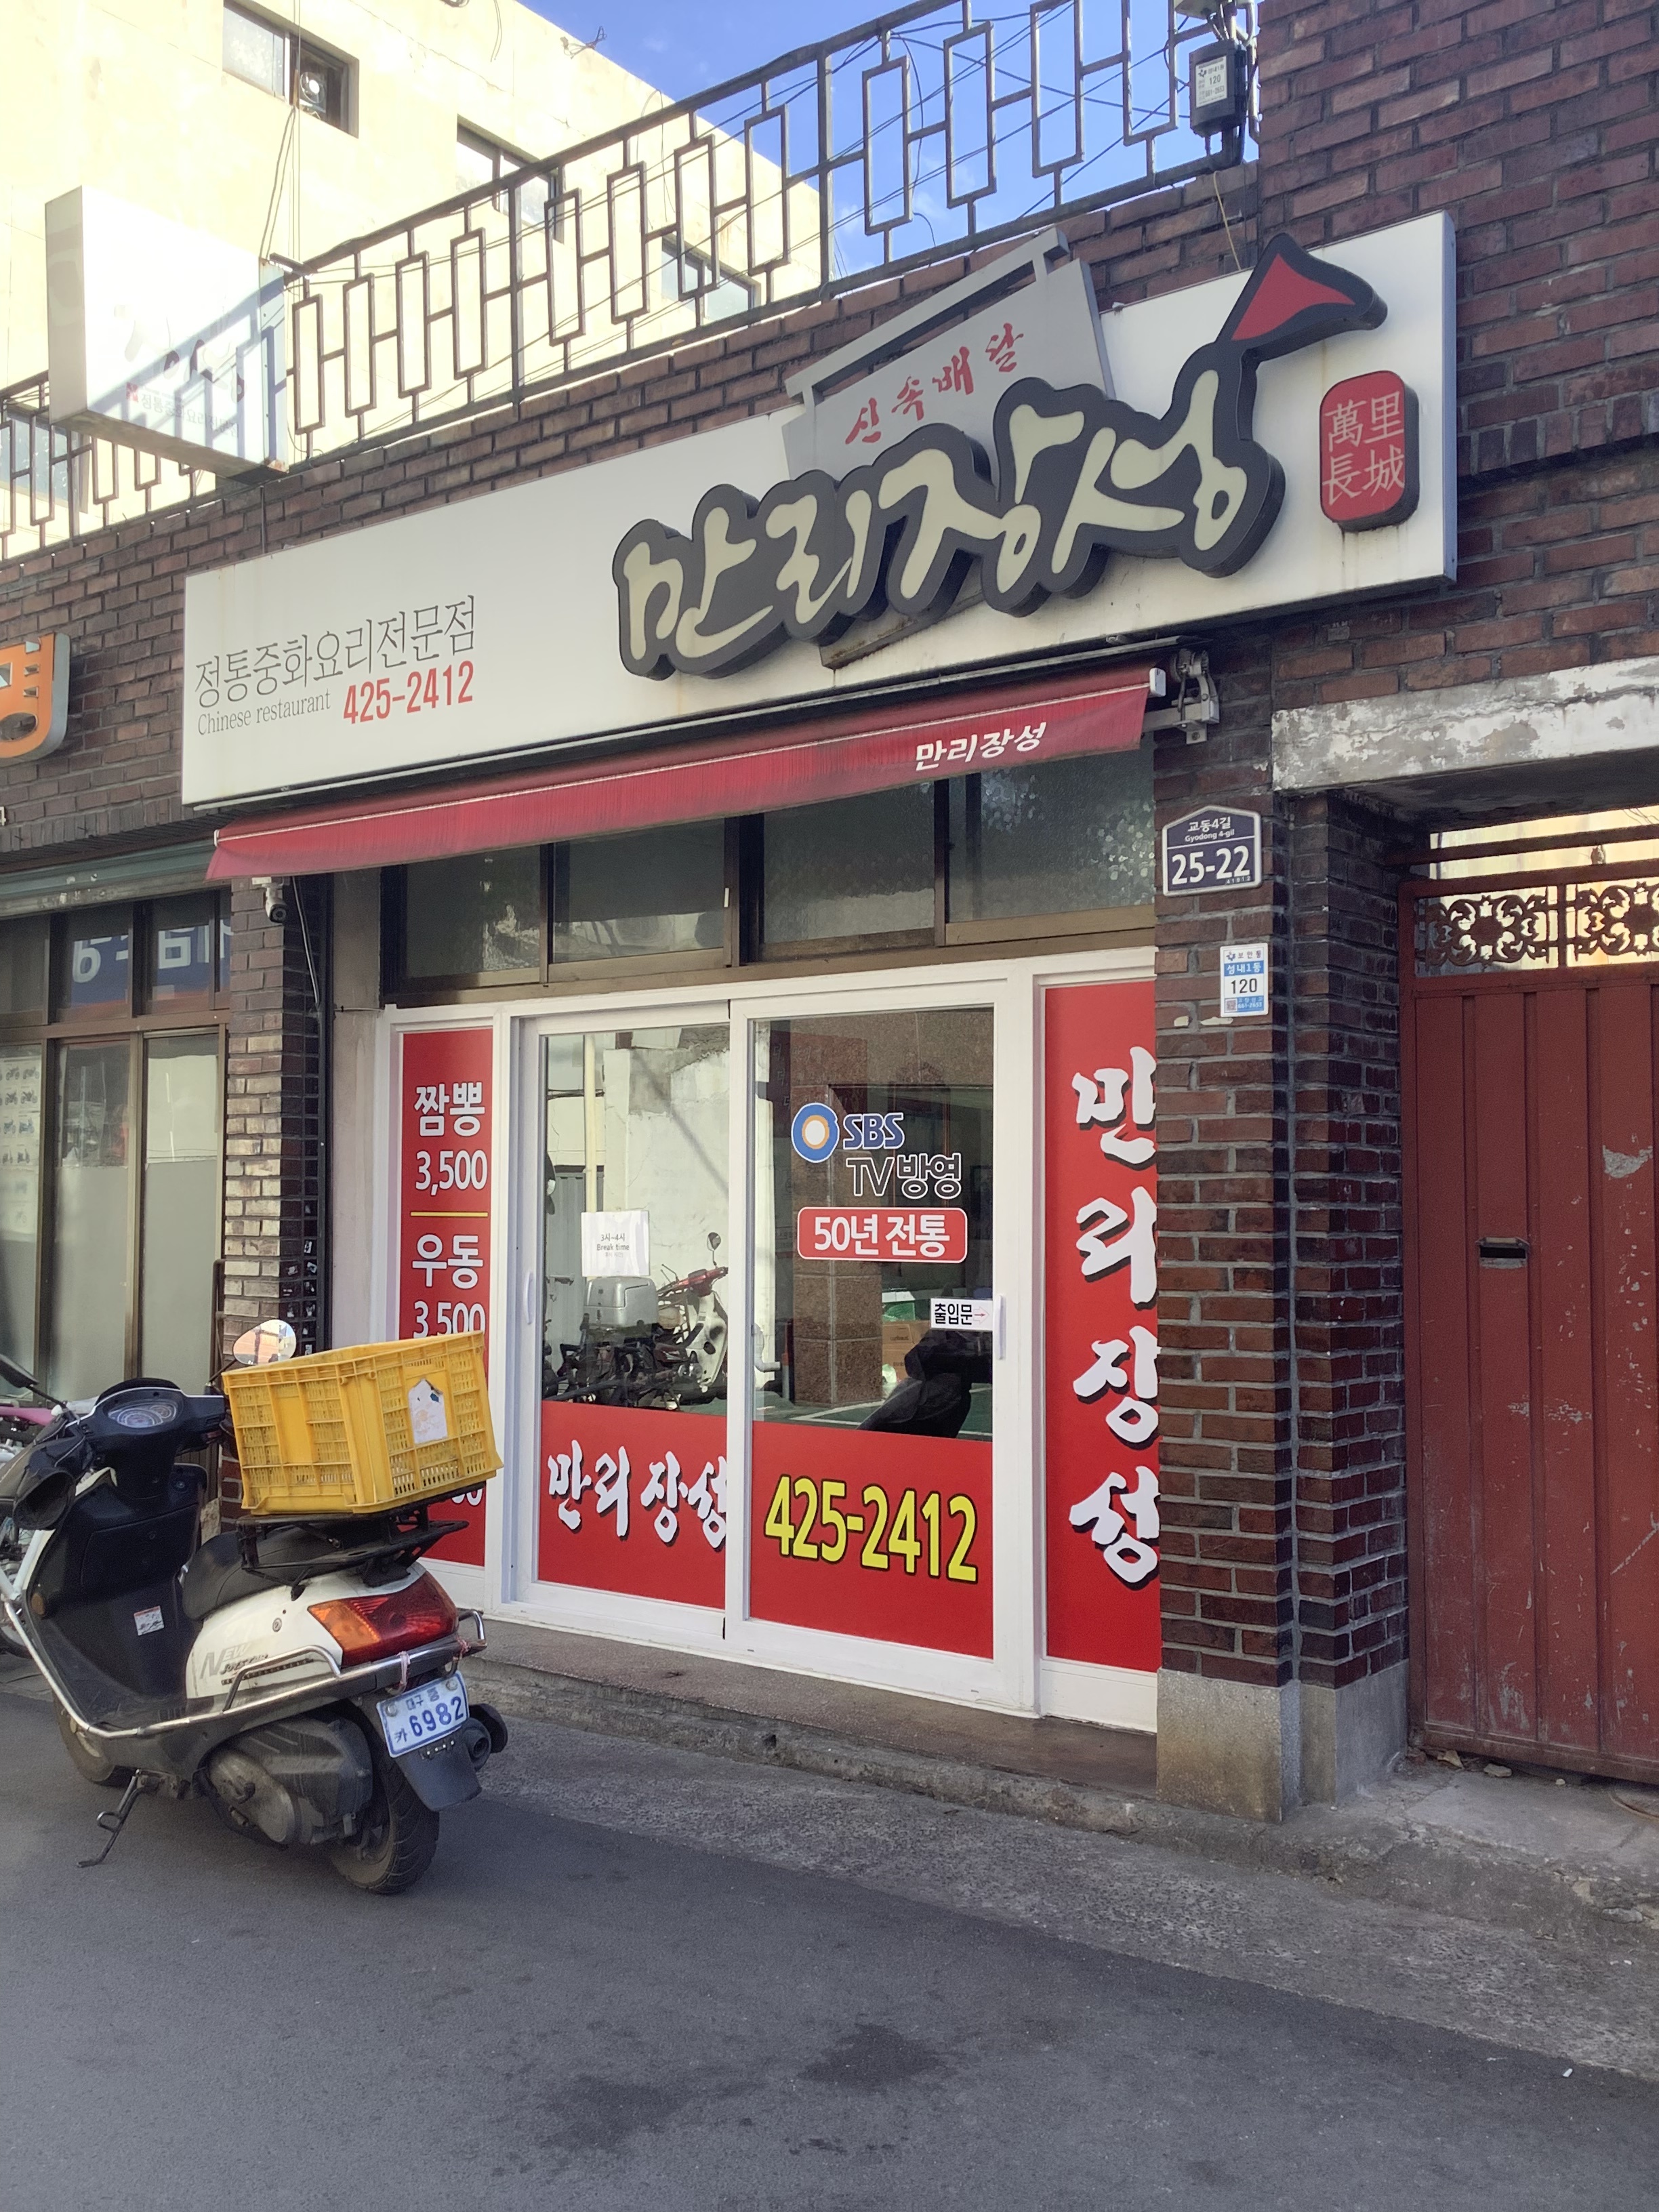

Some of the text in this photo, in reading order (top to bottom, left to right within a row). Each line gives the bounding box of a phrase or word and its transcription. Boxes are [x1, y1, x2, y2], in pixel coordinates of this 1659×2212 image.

[1324, 390, 1404, 453] 萬里
[1322, 444, 1405, 506] 長城
[619, 369, 1248, 661] 만리장성
[194, 594, 474, 708] 정통중화요리전문점
[197, 687, 331, 736] Chinese restaurant
[343, 660, 474, 724] 425-2412
[916, 721, 1047, 771] 만리장성
[1185, 829, 1235, 843] Gyodong 4-gil
[1187, 816, 1231, 832] 교동4길
[1172, 845, 1250, 885] 25-22
[1225, 876, 1251, 884] 41912
[1231, 978, 1257, 994] 120
[414, 1082, 486, 1137] 짬뽕
[843, 1112, 905, 1150] SBS
[415, 1149, 489, 1195] 3,500
[846, 1153, 962, 1199] TV방영
[596, 1243, 630, 1251] Break time
[814, 1214, 949, 1258] 50년 전통
[412, 1233, 483, 1289] 우동
[413, 1300, 486, 1339] 3500
[935, 1303, 972, 1326] 출입문
[1069, 1046, 1160, 1585] 만리장성
[548, 1439, 726, 1549] 만리장성
[764, 1475, 978, 1582] 425-2412
[409, 1696, 464, 1737] 6982
